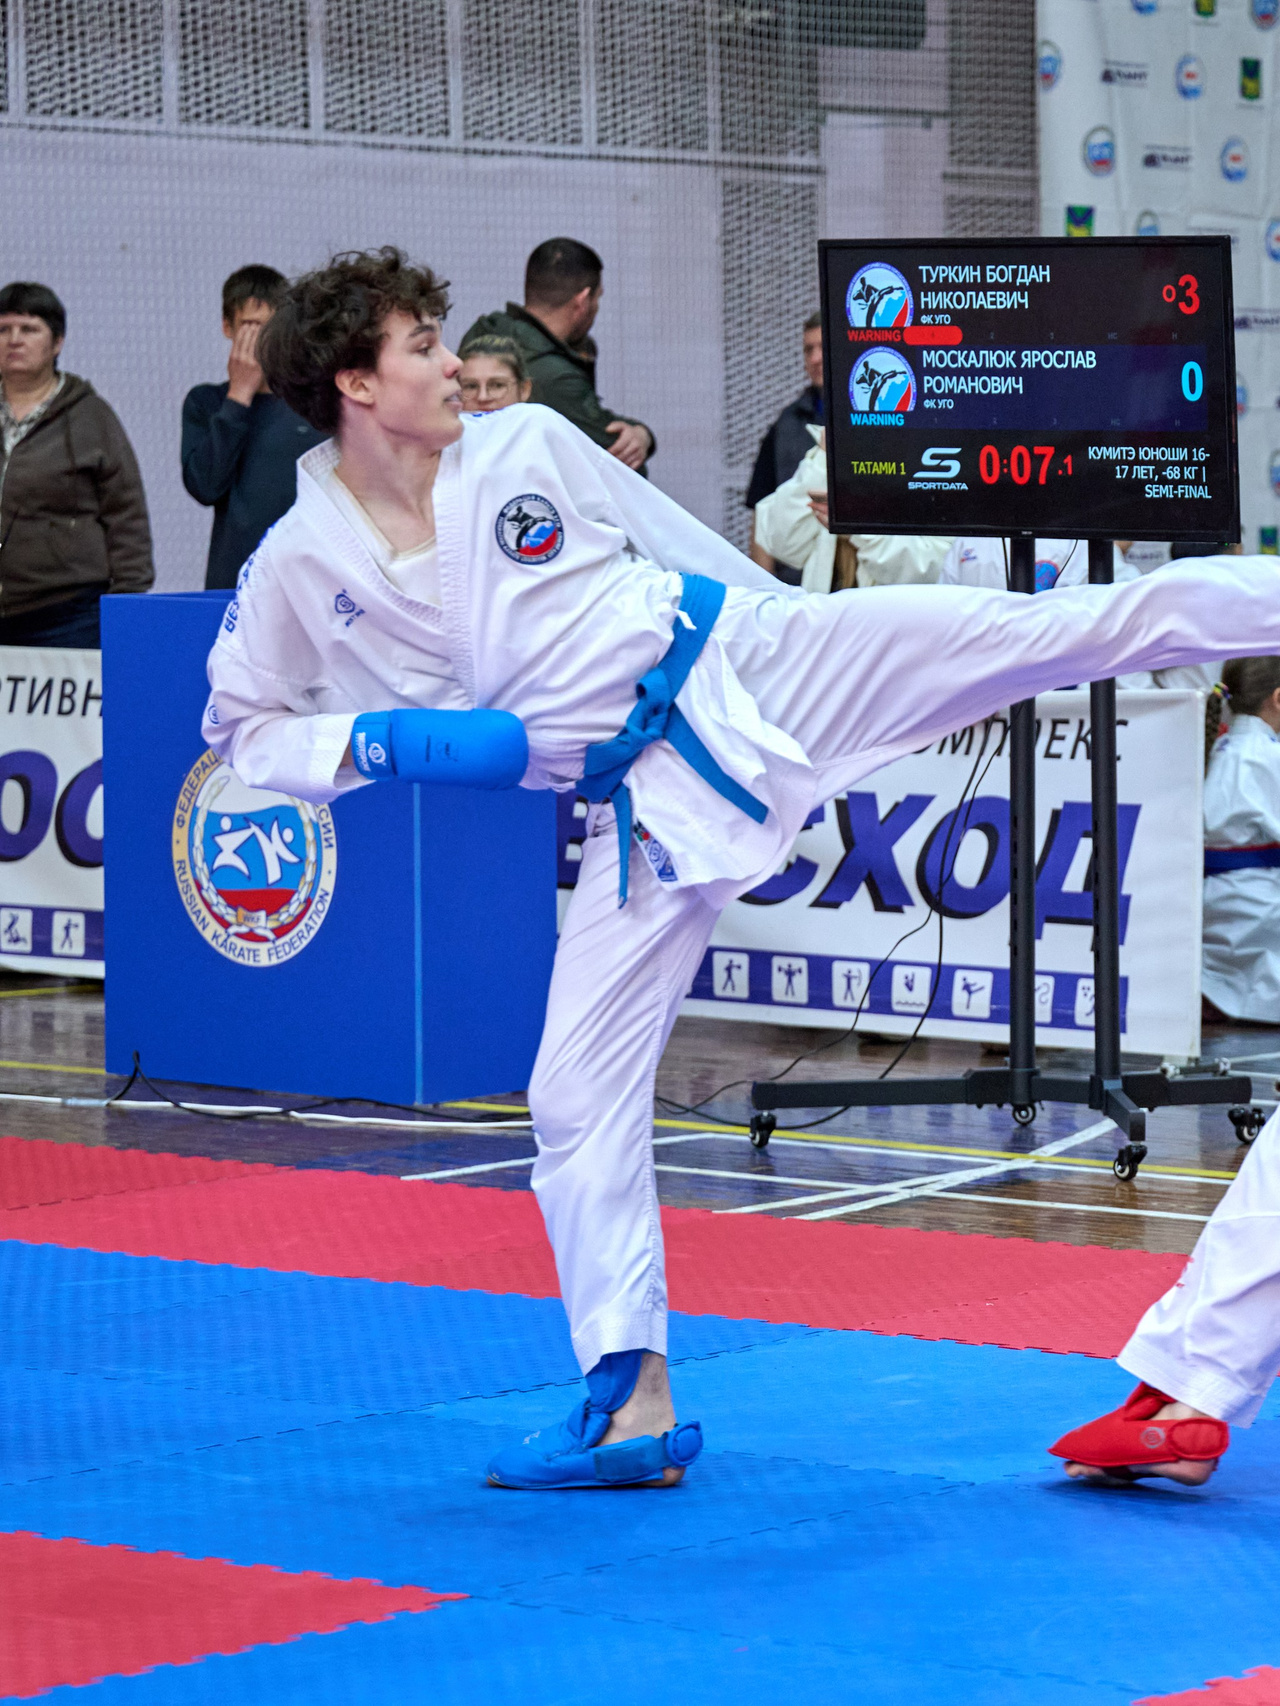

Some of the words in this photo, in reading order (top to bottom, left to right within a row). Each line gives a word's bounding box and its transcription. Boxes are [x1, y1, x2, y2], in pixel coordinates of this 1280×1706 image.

[919, 265, 981, 283] ТУРКИН
[986, 265, 1050, 286] БОГДАН
[920, 291, 1029, 309] НИКОЛАЕВИЧ
[920, 315, 934, 324] ФК
[935, 314, 951, 325] УГО
[847, 330, 902, 342] WARNING
[922, 350, 1017, 368] МОСКАЛЮК
[1021, 350, 1097, 369] ЯРОСЛАВ
[923, 376, 1024, 394] РОМАНОВИЧ
[1181, 361, 1204, 402] 0
[923, 400, 937, 409] ФК
[938, 399, 955, 410] УГО
[850, 413, 905, 426] WARNING
[1088, 446, 1136, 461] КУМИТЭ
[1139, 446, 1188, 461] ЮНОШИ
[1192, 448, 1211, 462] 16-
[851, 461, 896, 475] ТАТАМИ
[899, 462, 906, 476] 1
[1115, 466, 1129, 479] 17
[1131, 466, 1159, 482] ЛЕТ,
[1162, 466, 1181, 480] -68
[1184, 467, 1199, 480] КГ
[907, 482, 968, 491] SPORTDATA
[1144, 484, 1212, 499] SEMI-FINAL
[0, 675, 103, 718] ТИВН
[315, 803, 335, 849] СИИ
[176, 859, 209, 932] RUSSIAN
[211, 932, 261, 963] KARATE
[267, 888, 330, 962] FEDERATION
